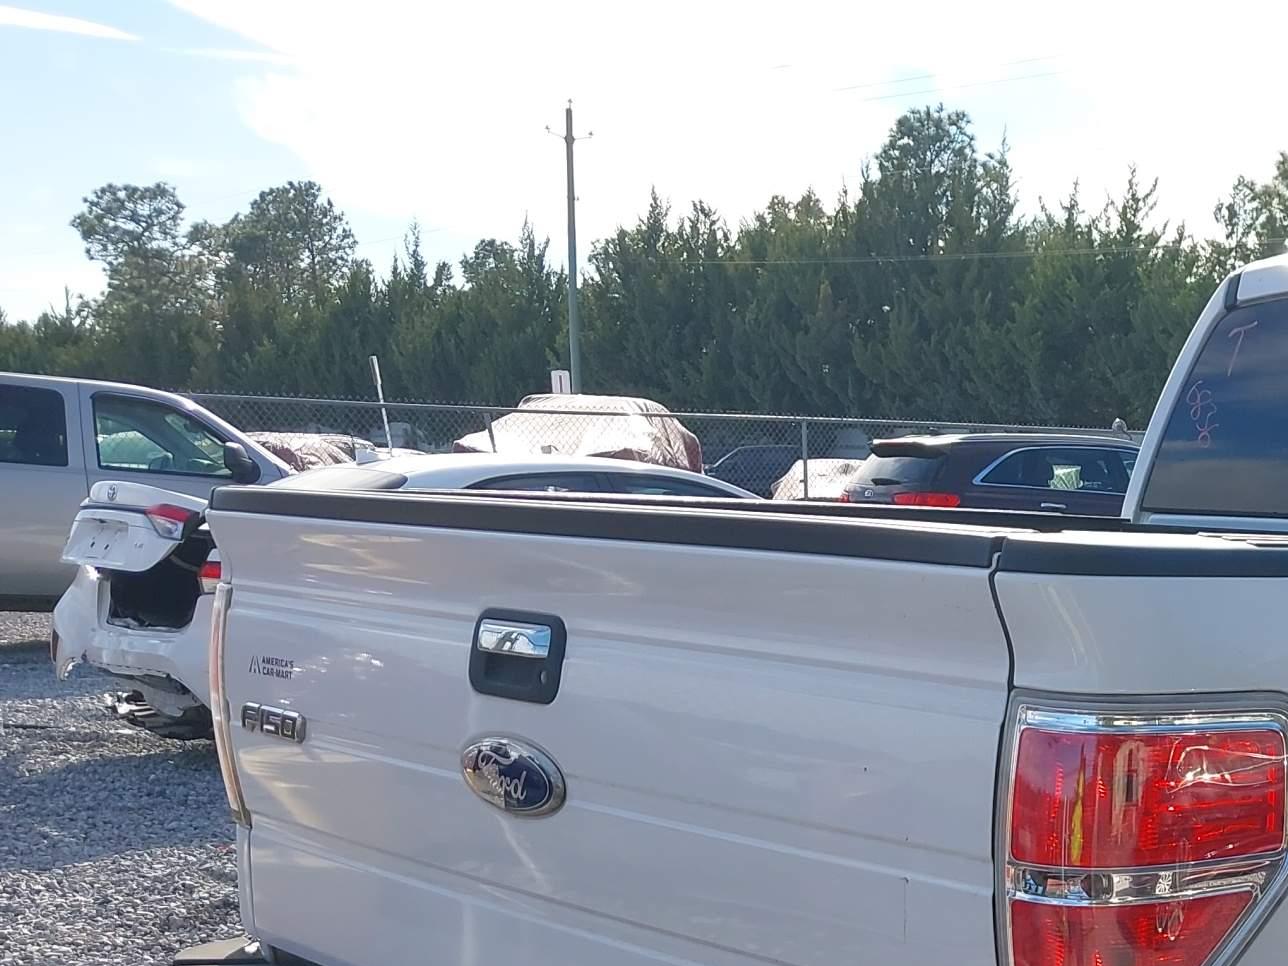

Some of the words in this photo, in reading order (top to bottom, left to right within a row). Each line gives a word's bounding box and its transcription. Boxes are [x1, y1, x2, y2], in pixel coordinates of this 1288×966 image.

[1228, 320, 1258, 376] T
[262, 655, 294, 670] AMERICA'S
[262, 666, 292, 681] CAR-MART
